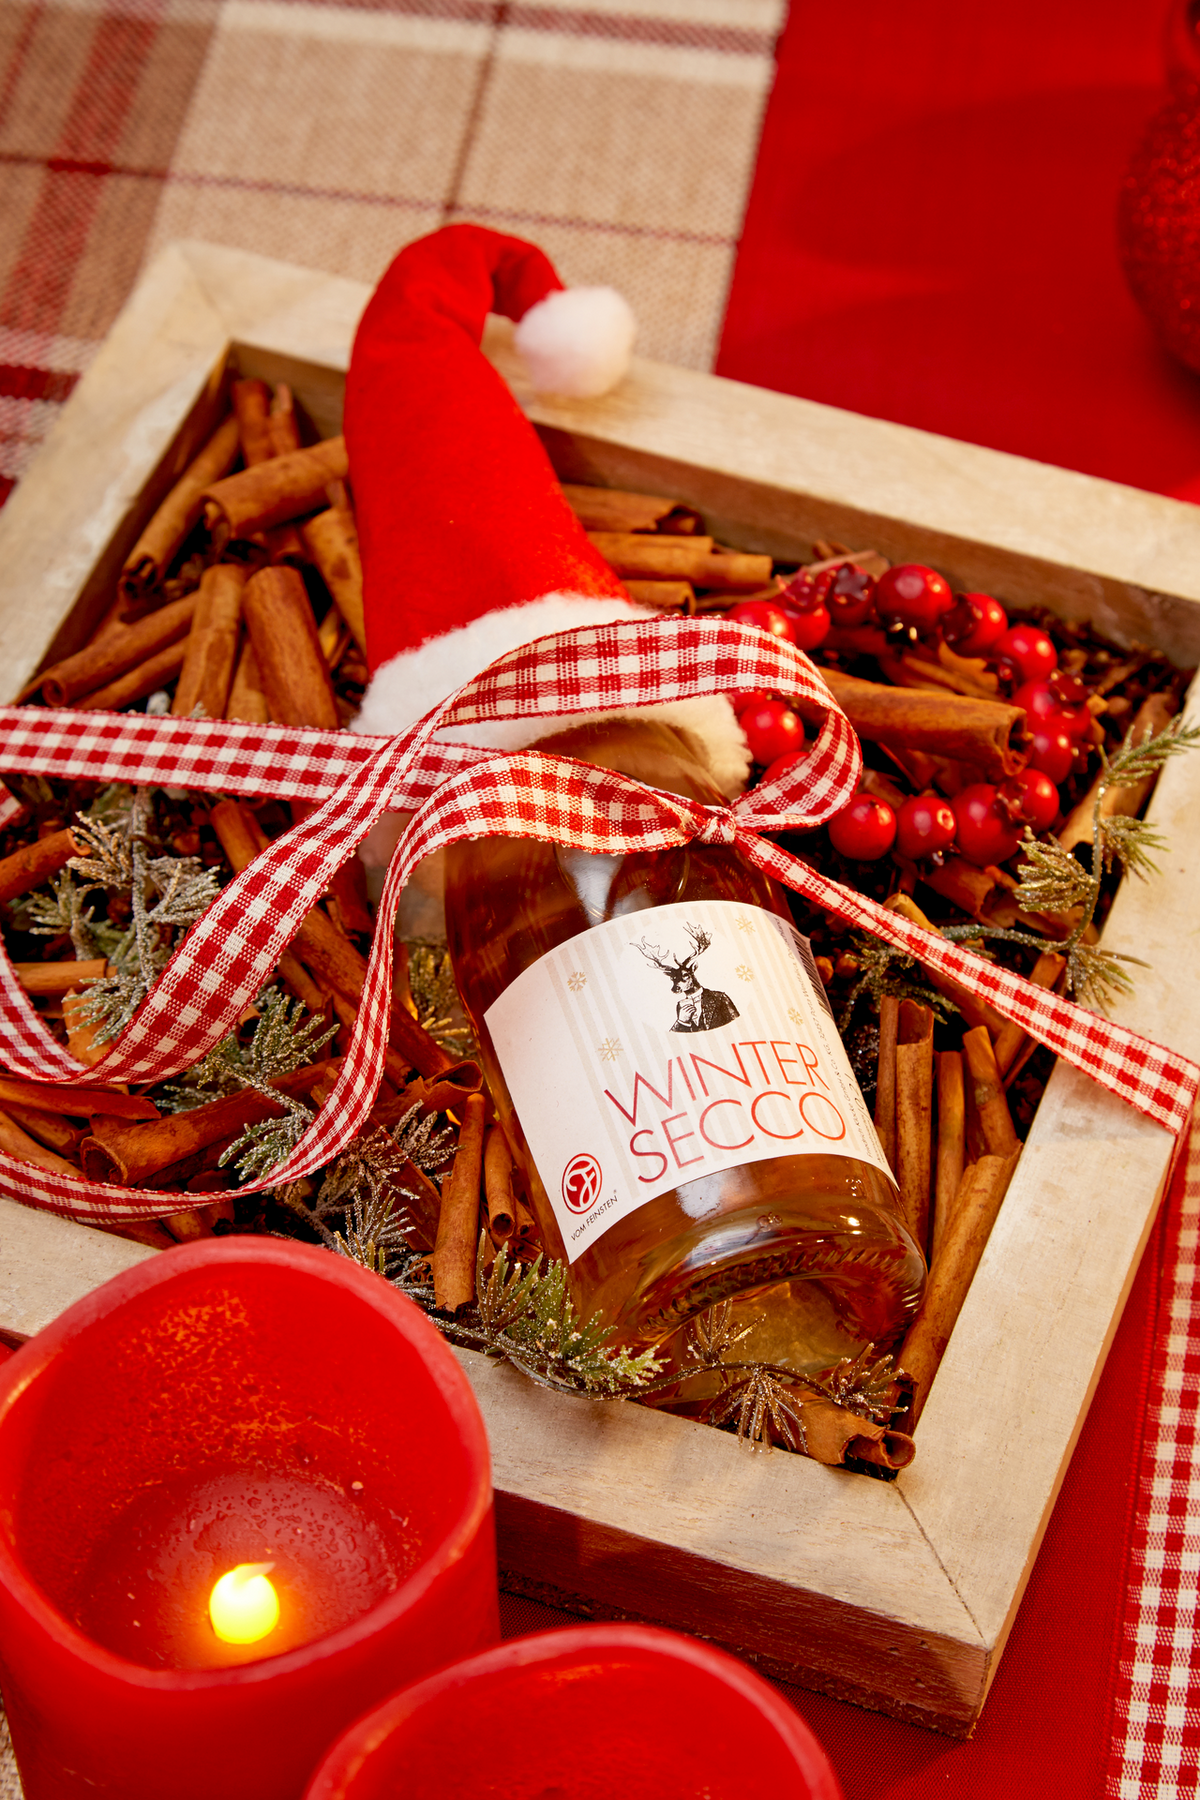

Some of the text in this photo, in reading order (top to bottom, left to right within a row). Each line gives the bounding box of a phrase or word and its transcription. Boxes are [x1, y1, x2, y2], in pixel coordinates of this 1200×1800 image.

[604, 1041, 831, 1127] WINTER
[629, 1090, 846, 1183] SECCO
[571, 1195, 618, 1241] VOM FEINSTEN
